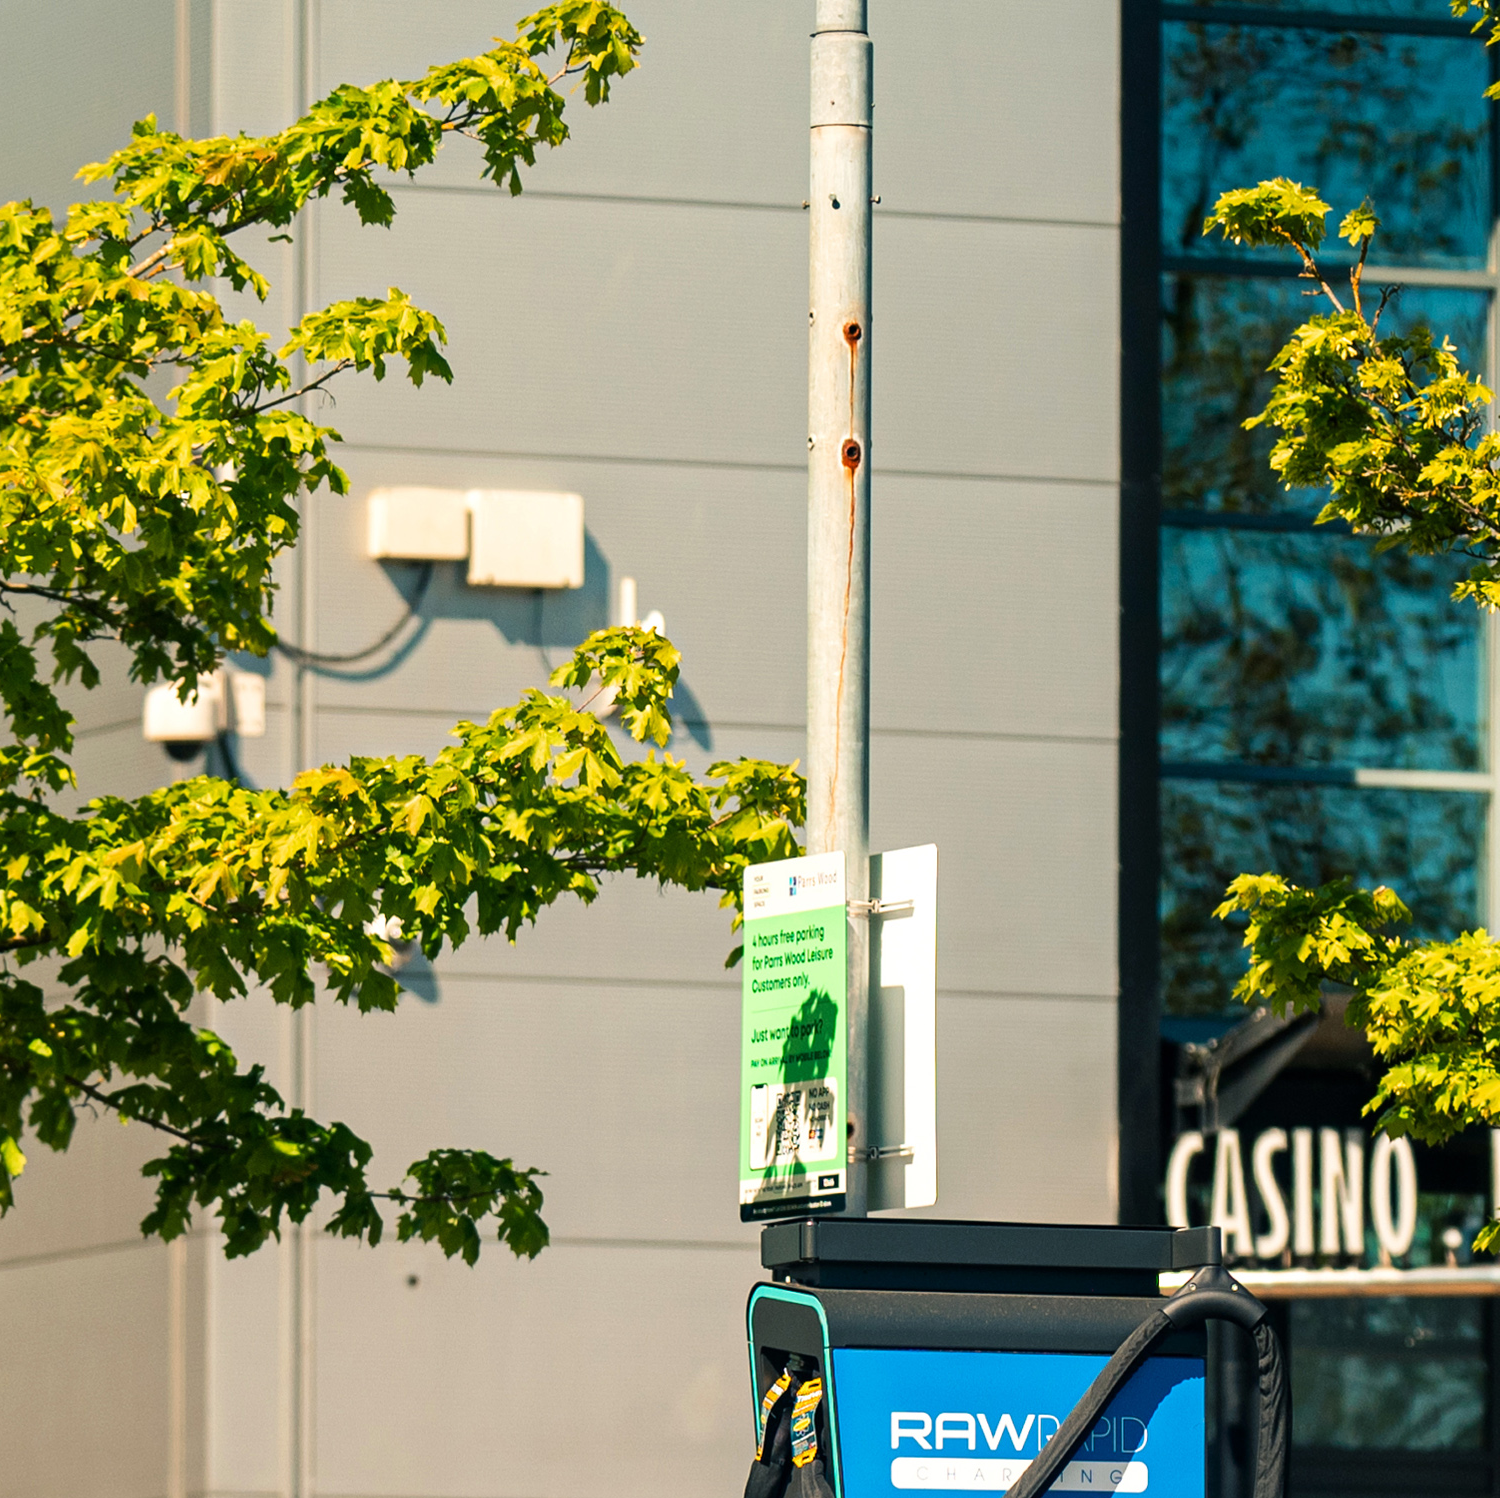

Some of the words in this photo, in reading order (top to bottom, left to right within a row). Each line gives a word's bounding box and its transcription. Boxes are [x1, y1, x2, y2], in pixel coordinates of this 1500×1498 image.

[752, 935, 757, 947] 4
[758, 933, 779, 948] hours
[780, 929, 795, 944] free
[796, 924, 825, 945] parking
[752, 956, 763, 971] for
[764, 955, 783, 969] Parrs
[784, 950, 806, 966] Wood
[807, 946, 834, 963] Leisure
[752, 979, 791, 994] Customers
[751, 1028, 768, 1043] Just
[769, 1026, 789, 1041] want
[1165, 1126, 1417, 1257] CASINO
[916, 1466, 1126, 1484] CHARING
